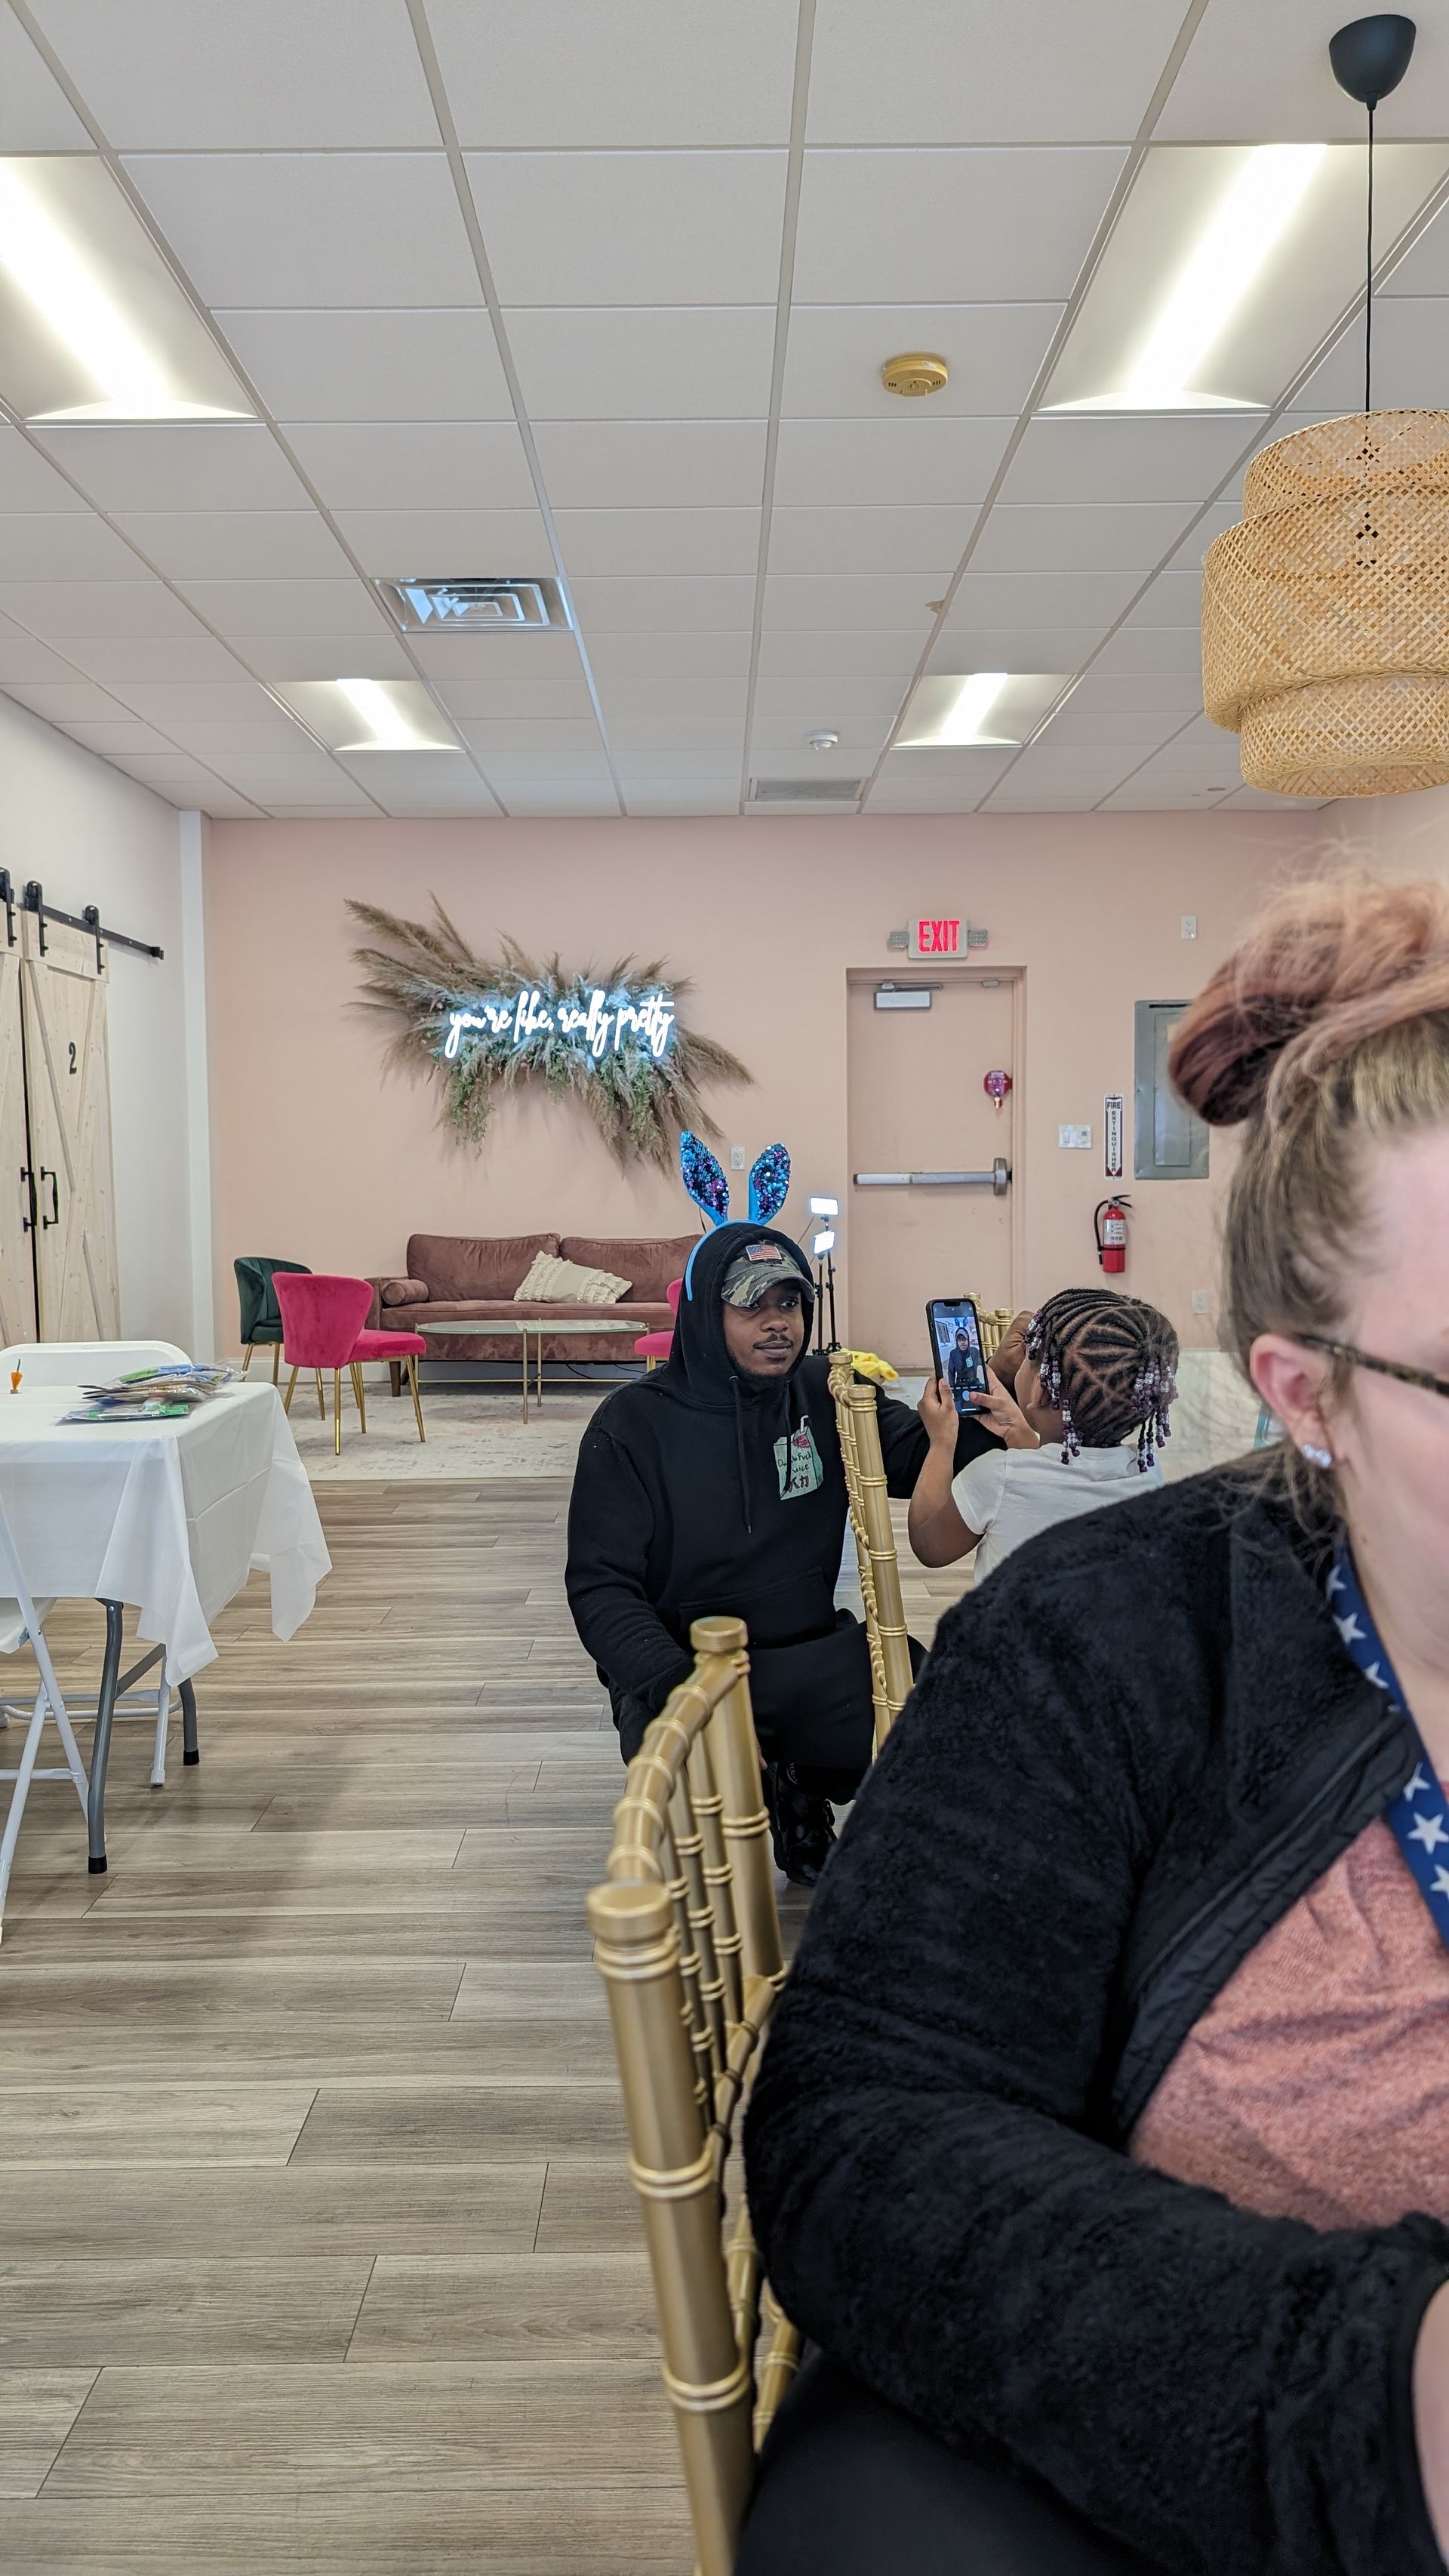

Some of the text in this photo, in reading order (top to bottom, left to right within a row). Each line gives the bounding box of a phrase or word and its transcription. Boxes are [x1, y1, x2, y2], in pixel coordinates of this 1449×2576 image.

[918, 920, 960, 953] EXIT
[445, 1005, 513, 1058] you're
[557, 989, 615, 1057] really
[614, 993, 675, 1057] pretty
[69, 1042, 77, 1075] 2
[1106, 1101, 1121, 1109] FIRE
[777, 1454, 798, 1467] Dub
[786, 1463, 810, 1475] uice
